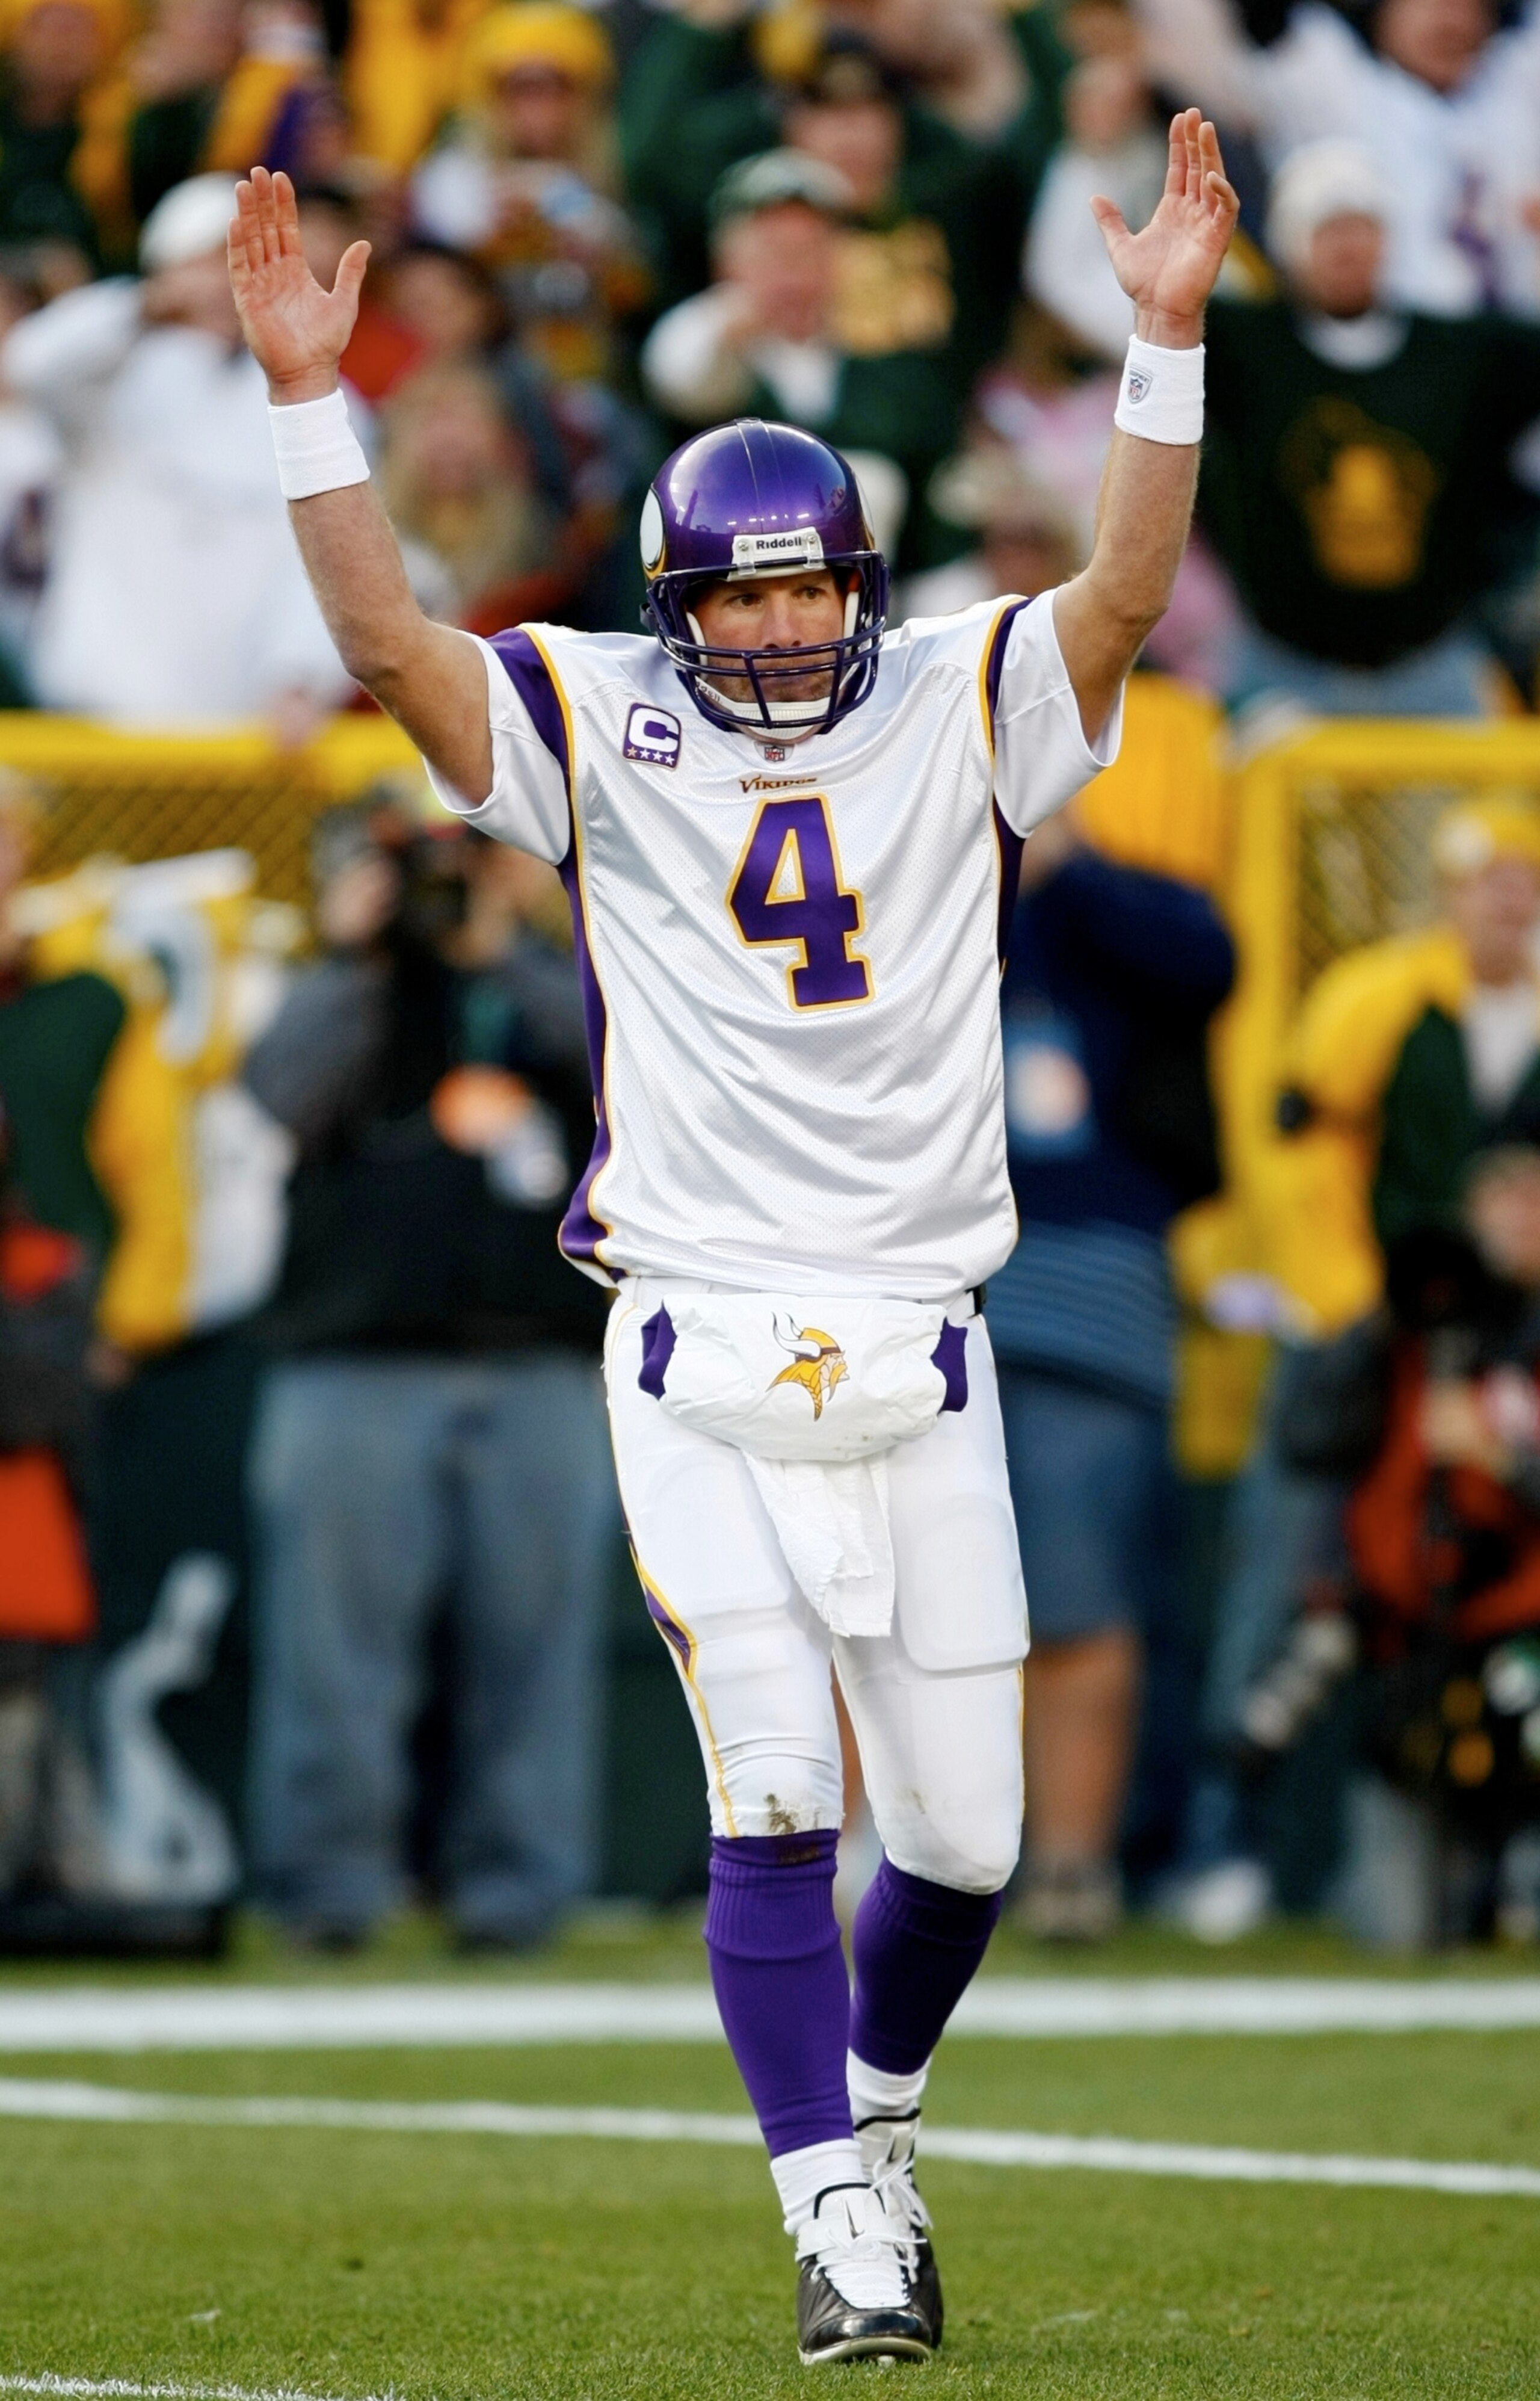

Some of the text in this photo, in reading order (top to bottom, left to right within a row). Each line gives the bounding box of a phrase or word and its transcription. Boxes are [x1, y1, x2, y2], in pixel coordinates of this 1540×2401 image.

[756, 536, 802, 549] Riddell
[629, 708, 679, 752] C
[725, 794, 875, 1012] 4
